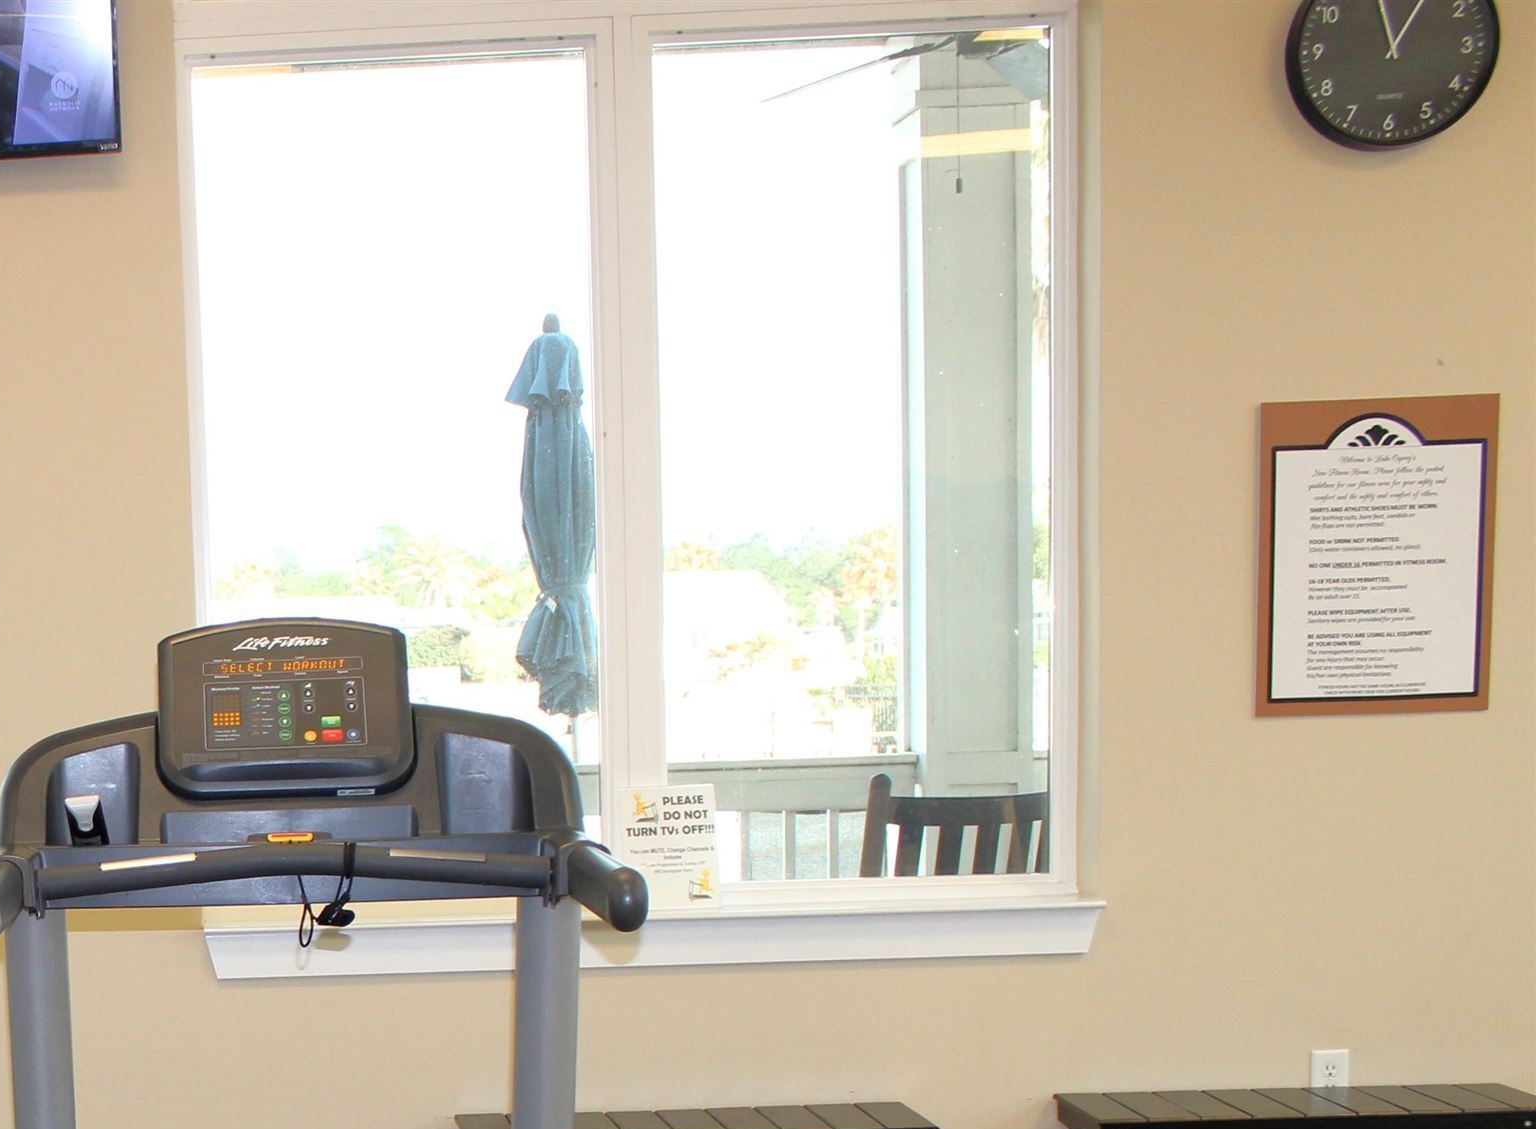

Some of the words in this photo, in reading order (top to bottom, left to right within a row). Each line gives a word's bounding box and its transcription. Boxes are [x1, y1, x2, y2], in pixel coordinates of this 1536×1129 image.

[1322, 6, 1339, 23] 10
[1453, 1, 1465, 18] 2
[1312, 44, 1323, 60] 9
[1461, 36, 1473, 54] 3
[1321, 80, 1333, 96] 8
[1448, 74, 1459, 90] 4
[1347, 105, 1358, 122] 7
[1420, 102, 1432, 119] 5
[1383, 114, 1394, 131] 6
[220, 662, 272, 674] SELECT
[283, 660, 345, 671] WORKOUT
[662, 795, 704, 805] PLEASE
[664, 811, 680, 820] DO
[684, 810, 708, 819] NOT
[626, 827, 657, 837] TURN
[661, 826, 679, 835] TVs
[682, 824, 714, 834] OFF!!!
